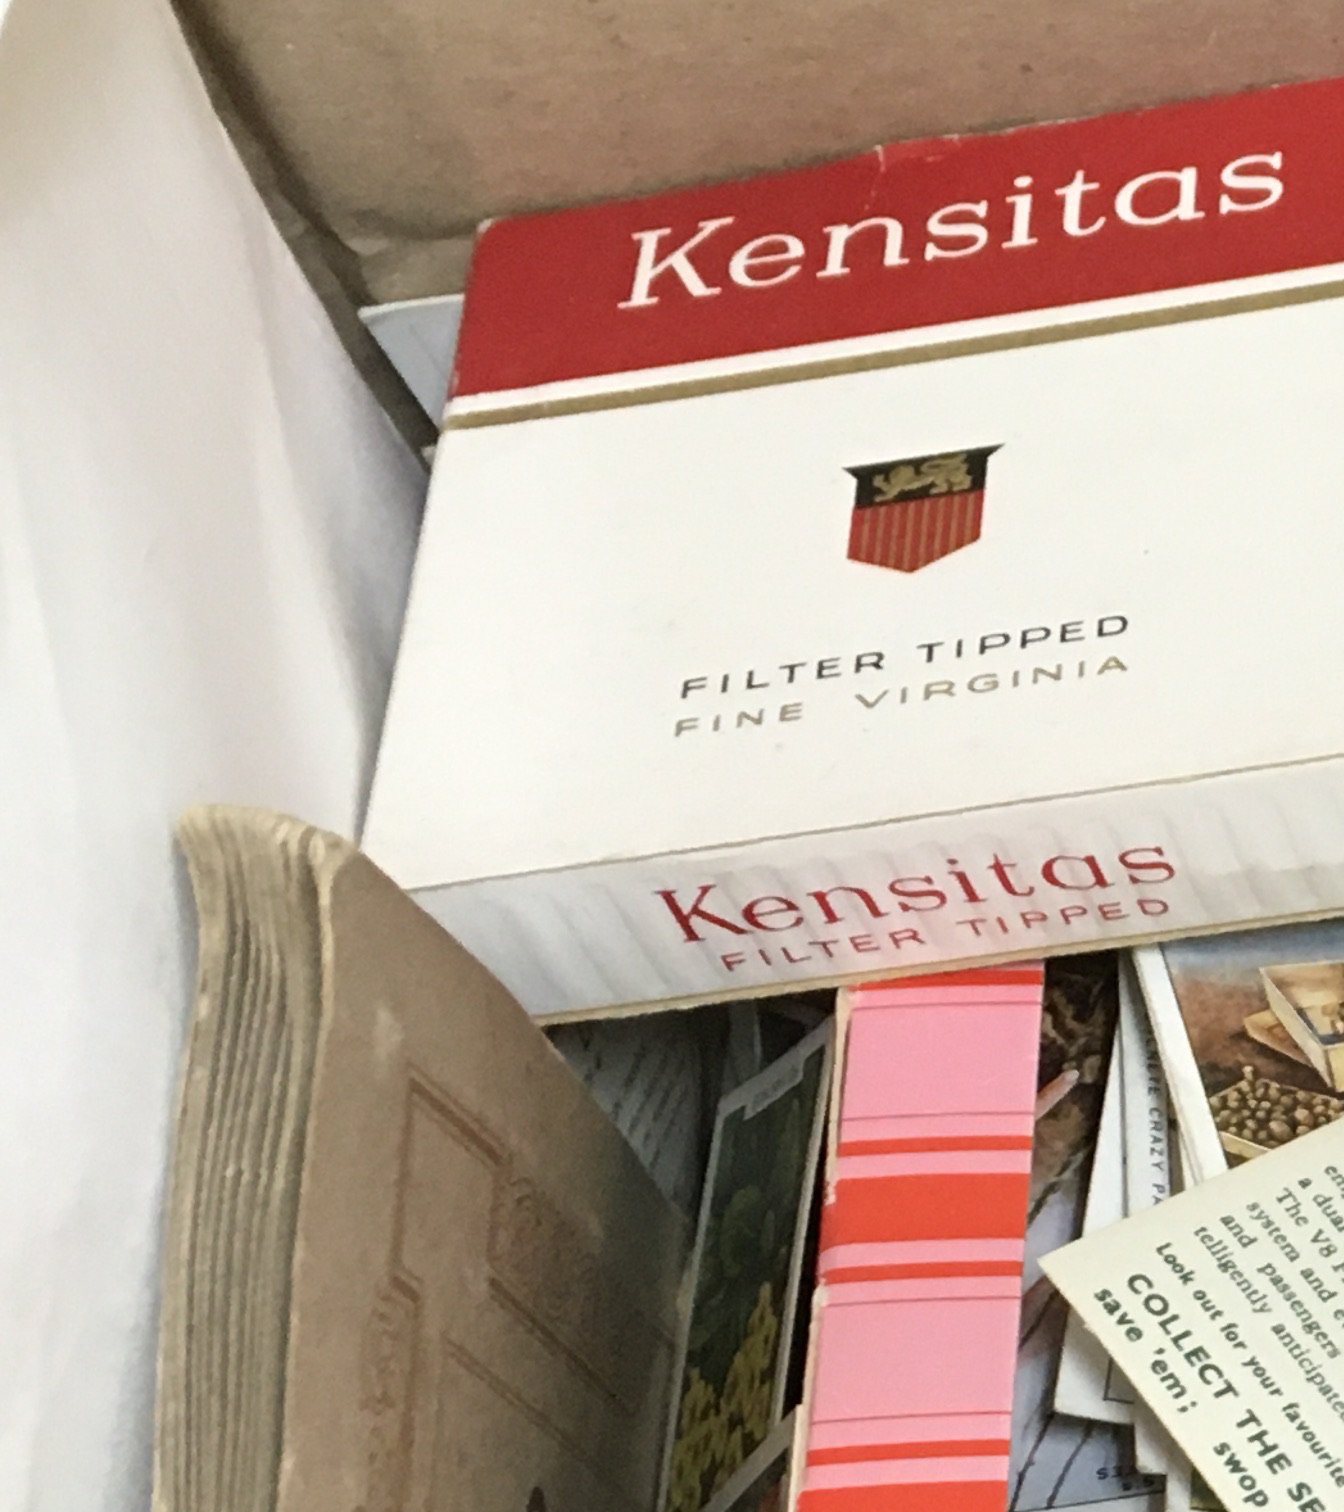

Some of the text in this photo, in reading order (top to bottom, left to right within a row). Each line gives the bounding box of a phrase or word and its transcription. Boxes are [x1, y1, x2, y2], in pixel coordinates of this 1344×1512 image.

[618, 149, 1286, 311] Kensitas
[672, 655, 1130, 738] FINE VIRGINIA
[681, 613, 1132, 700] FILTER TIPPED
[654, 838, 1177, 945] Kensitas
[720, 896, 1172, 974] FILTER TIPPED
[1145, 1105, 1173, 1171] CRAZY
[1093, 1286, 1144, 1345] save
[1212, 1440, 1269, 1510] swop
[1125, 1269, 1238, 1405] COLLECT
[1234, 1408, 1292, 1476] THE
